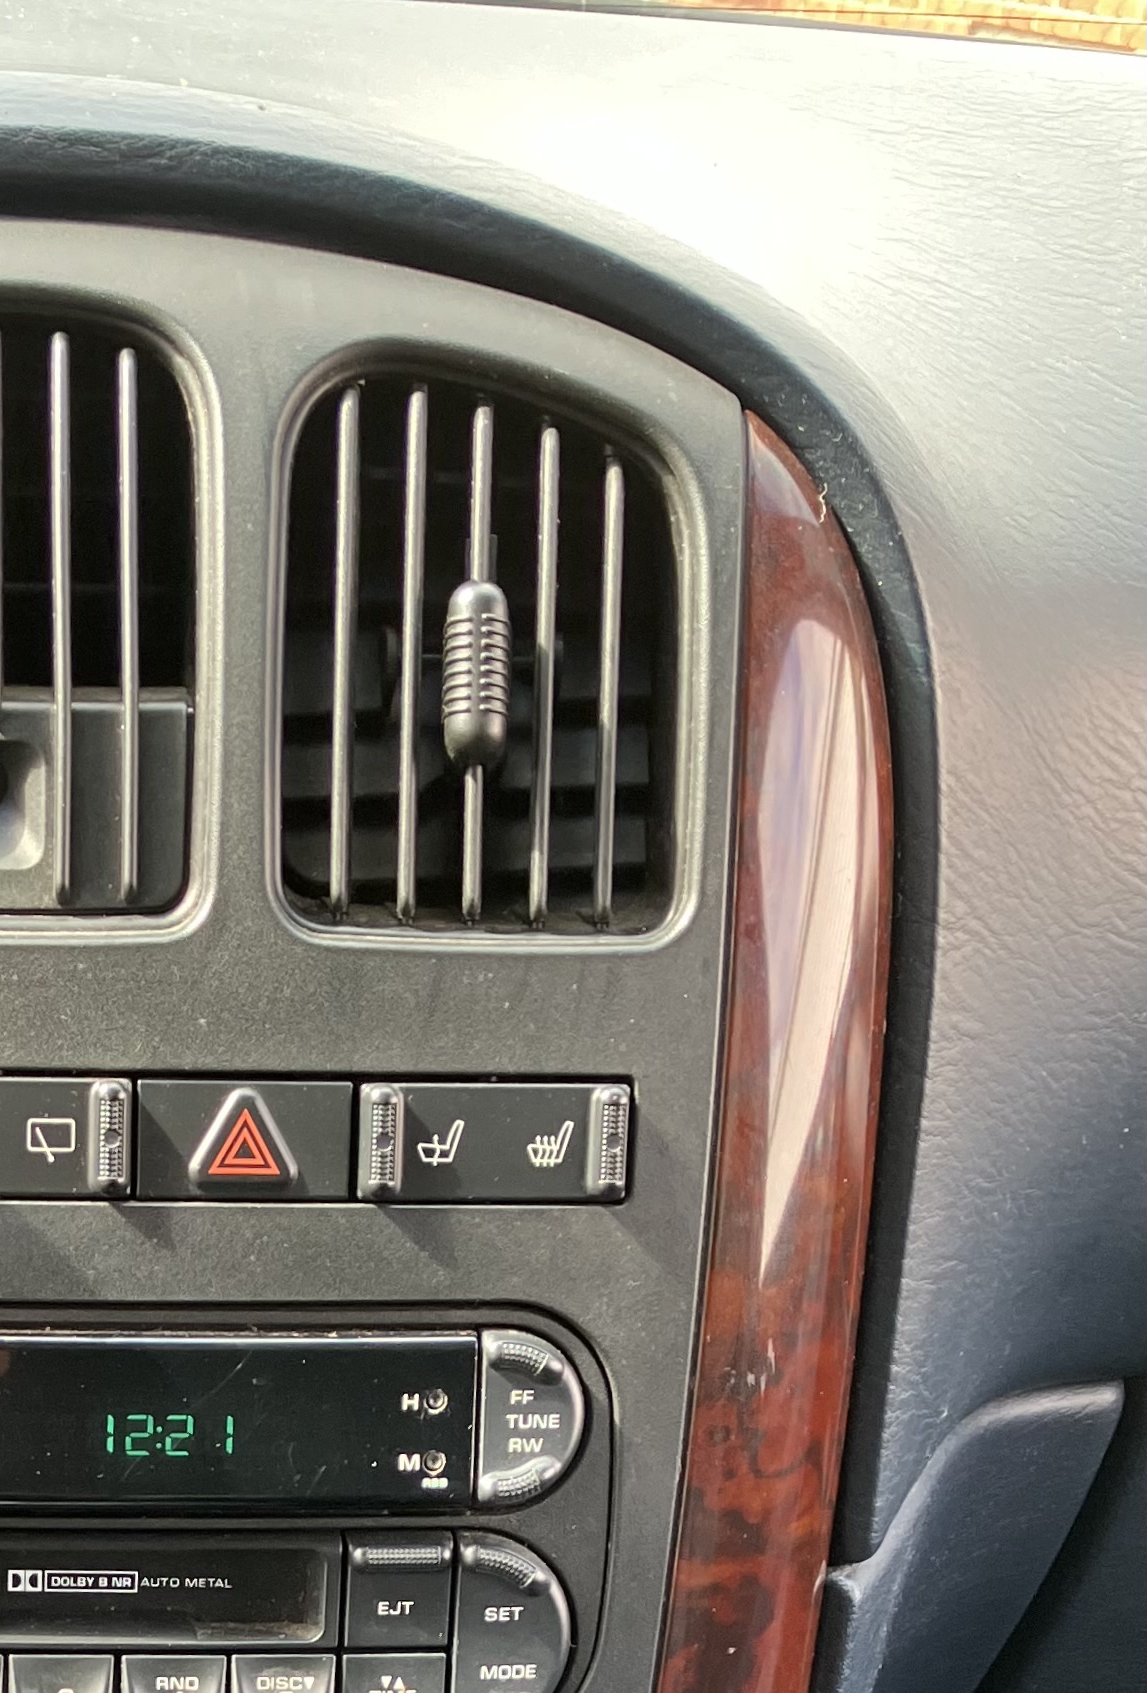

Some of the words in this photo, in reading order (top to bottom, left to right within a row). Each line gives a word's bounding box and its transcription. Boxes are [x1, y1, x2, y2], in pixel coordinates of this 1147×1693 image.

[401, 1393, 419, 1410] H
[509, 1389, 535, 1406] FF
[505, 1413, 561, 1429] TUNE
[106, 1413, 234, 1457] 12:21
[507, 1437, 543, 1454] RW
[397, 1453, 421, 1472] M
[51, 1576, 94, 1587] DOLBY
[98, 1576, 109, 1588] B
[112, 1576, 132, 1588] NR
[140, 1577, 181, 1589] AUTO
[184, 1577, 233, 1589] METAL
[377, 1601, 414, 1616] EJT
[484, 1606, 524, 1622] SET
[479, 1664, 537, 1680] MODE
[155, 1676, 200, 1691] RND
[256, 1676, 305, 1691] DISC
